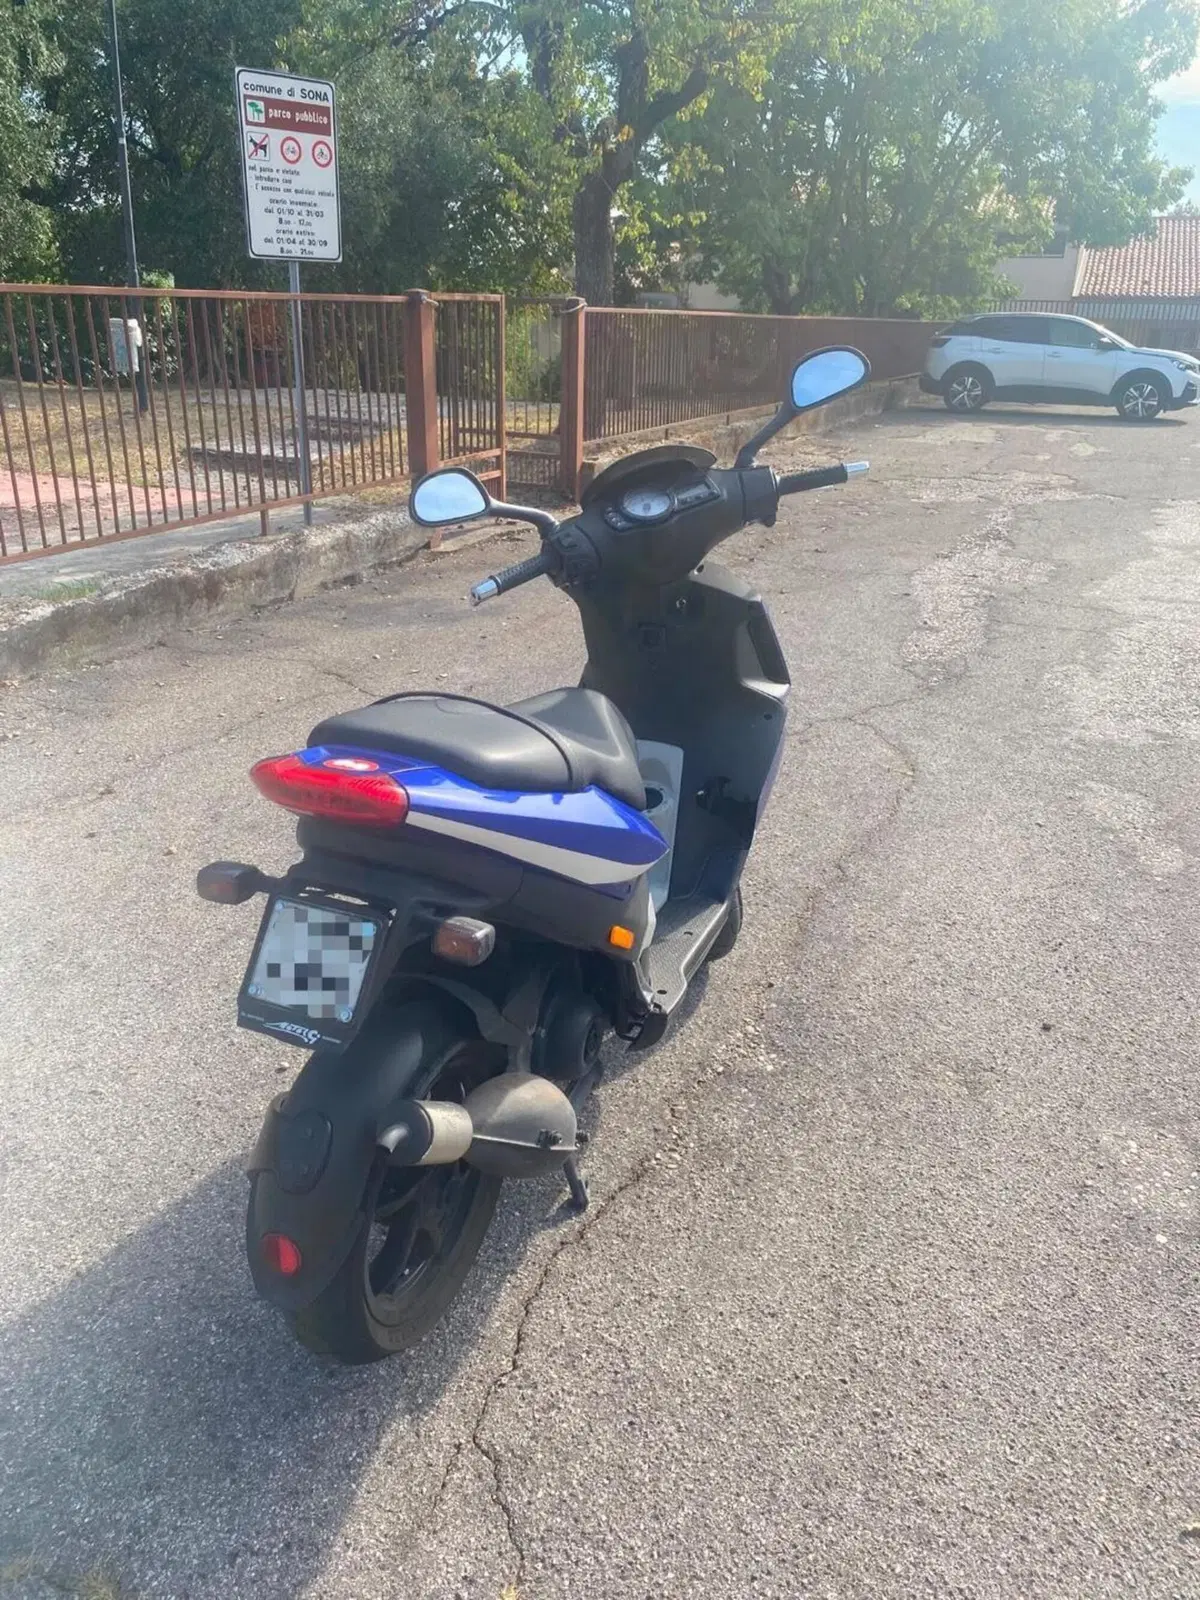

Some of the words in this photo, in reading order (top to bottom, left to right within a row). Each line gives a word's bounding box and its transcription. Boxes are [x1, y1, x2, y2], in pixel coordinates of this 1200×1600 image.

[243, 82, 282, 95] comune
[287, 88, 295, 97] di
[300, 88, 330, 102] SONA
[268, 108, 291, 119] parco
[295, 111, 328, 125] pubblico
[264, 206, 274, 214] dal
[276, 207, 295, 216] 01/10
[276, 237, 297, 245] 01/04
[307, 239, 328, 247] 30/09
